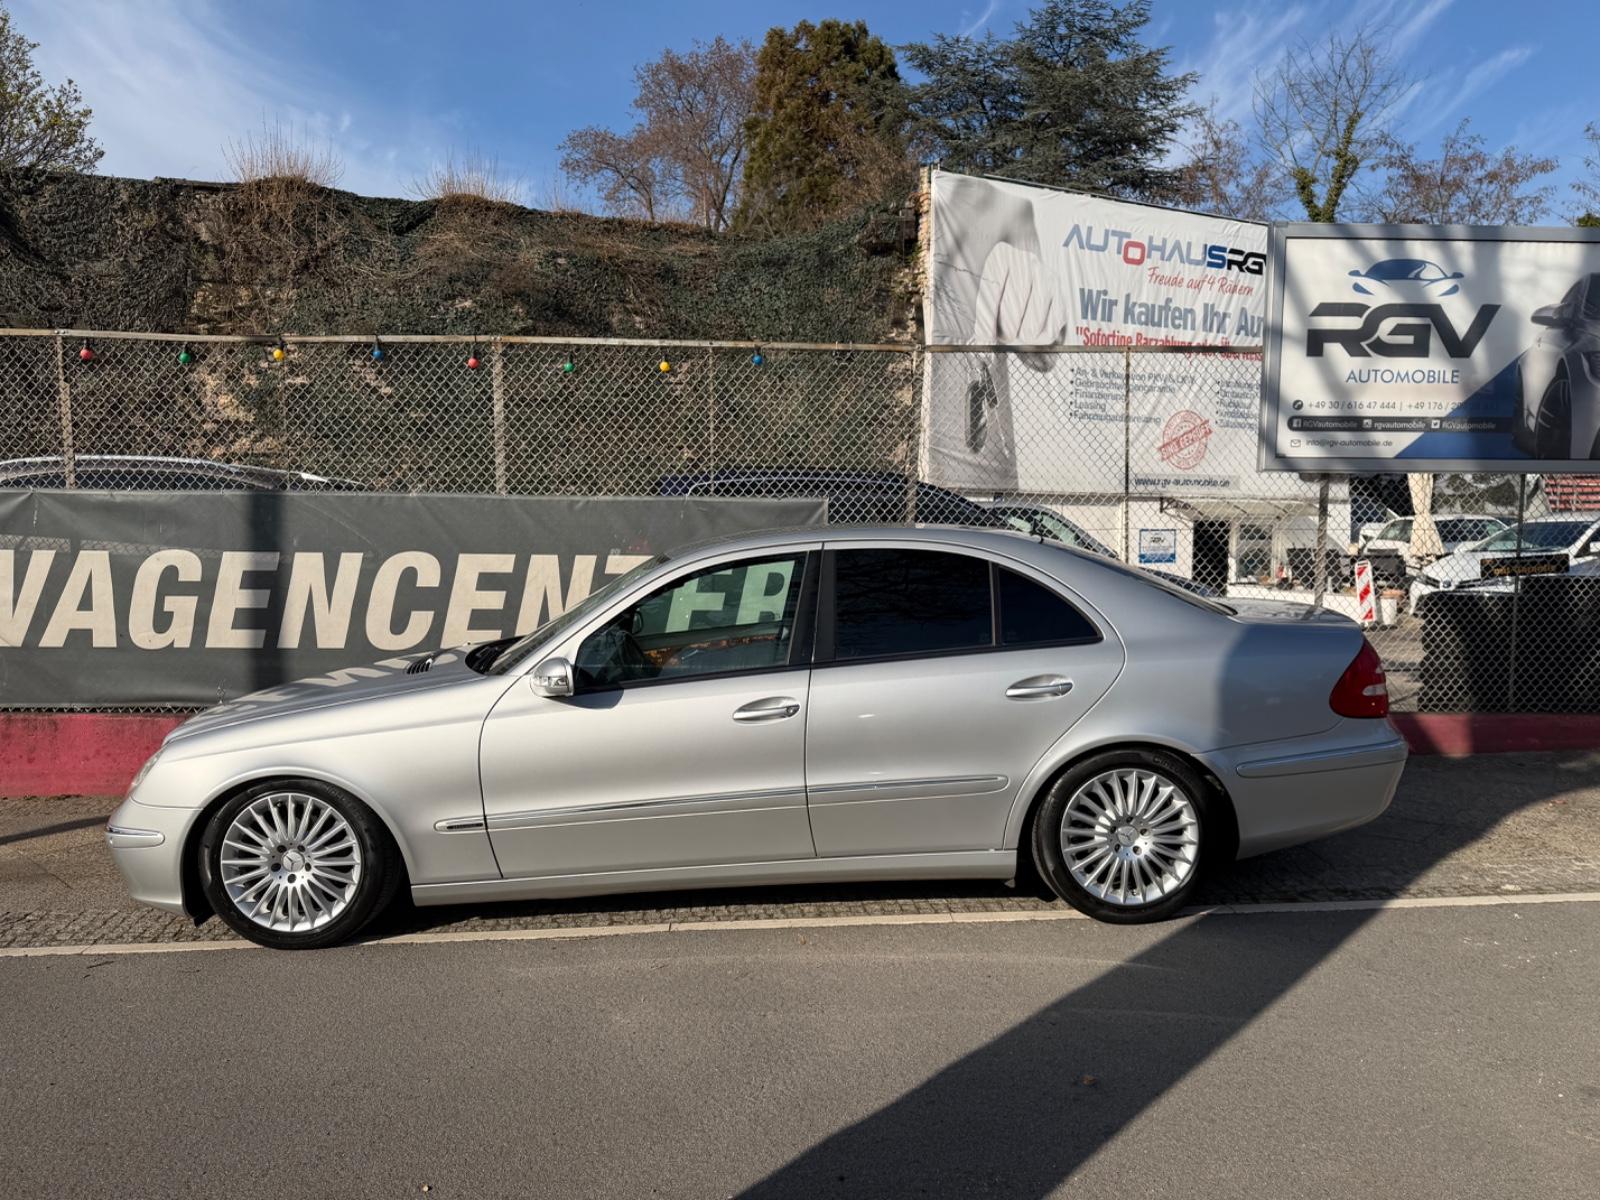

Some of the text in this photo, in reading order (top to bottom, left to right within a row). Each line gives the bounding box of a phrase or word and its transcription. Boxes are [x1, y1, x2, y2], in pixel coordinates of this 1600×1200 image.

[1148, 266, 1254, 296] Freude auf 4 Rädern
[1079, 287, 1118, 323] Wir
[1123, 293, 1196, 331] kaufen
[1202, 302, 1231, 334] Ihr
[1306, 302, 1501, 358] RGV
[1346, 369, 1460, 384] AUTOMOBILE
[1308, 401, 1325, 410] +49
[1328, 401, 1339, 410] 30
[1347, 401, 1364, 410] 616
[1366, 401, 1377, 410] 47
[1380, 401, 1396, 410] 444
[1408, 401, 1424, 410] +49
[1428, 401, 1442, 410] 176
[1374, 420, 1426, 430] rgvautomobile
